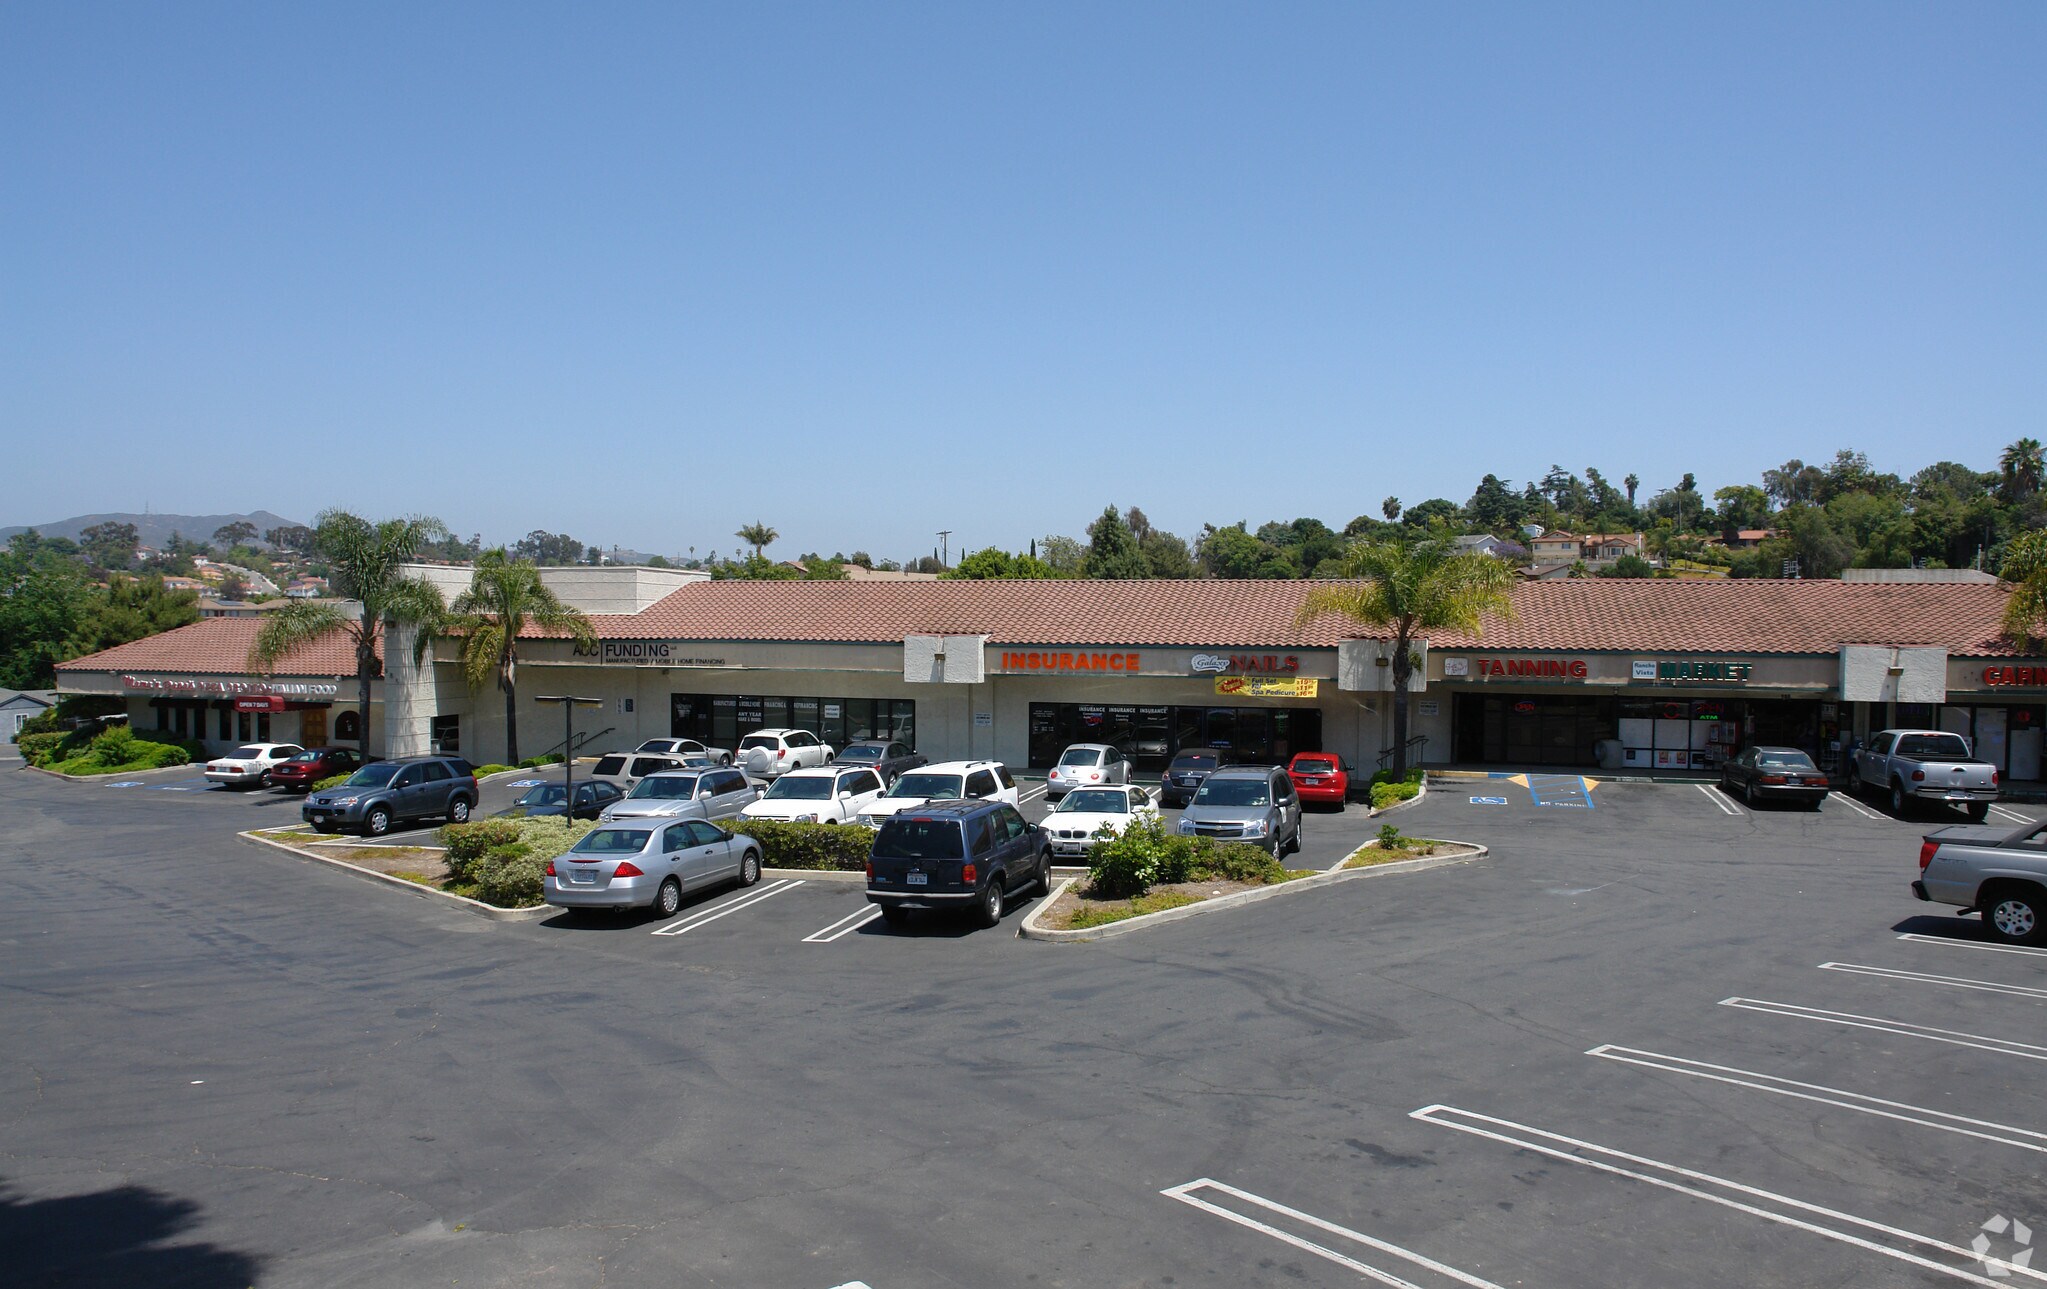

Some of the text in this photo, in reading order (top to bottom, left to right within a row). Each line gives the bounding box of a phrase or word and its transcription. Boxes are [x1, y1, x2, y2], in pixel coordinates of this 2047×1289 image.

[605, 643, 669, 657] FUNDING
[1002, 652, 1140, 671] INSURANCE
[1196, 655, 1300, 672] Galaxy NAILS
[1478, 659, 1588, 679] TANNING
[1660, 661, 1752, 682] MARKET
[271, 683, 308, 694] ITALIAN
[309, 684, 337, 695] FOOD
